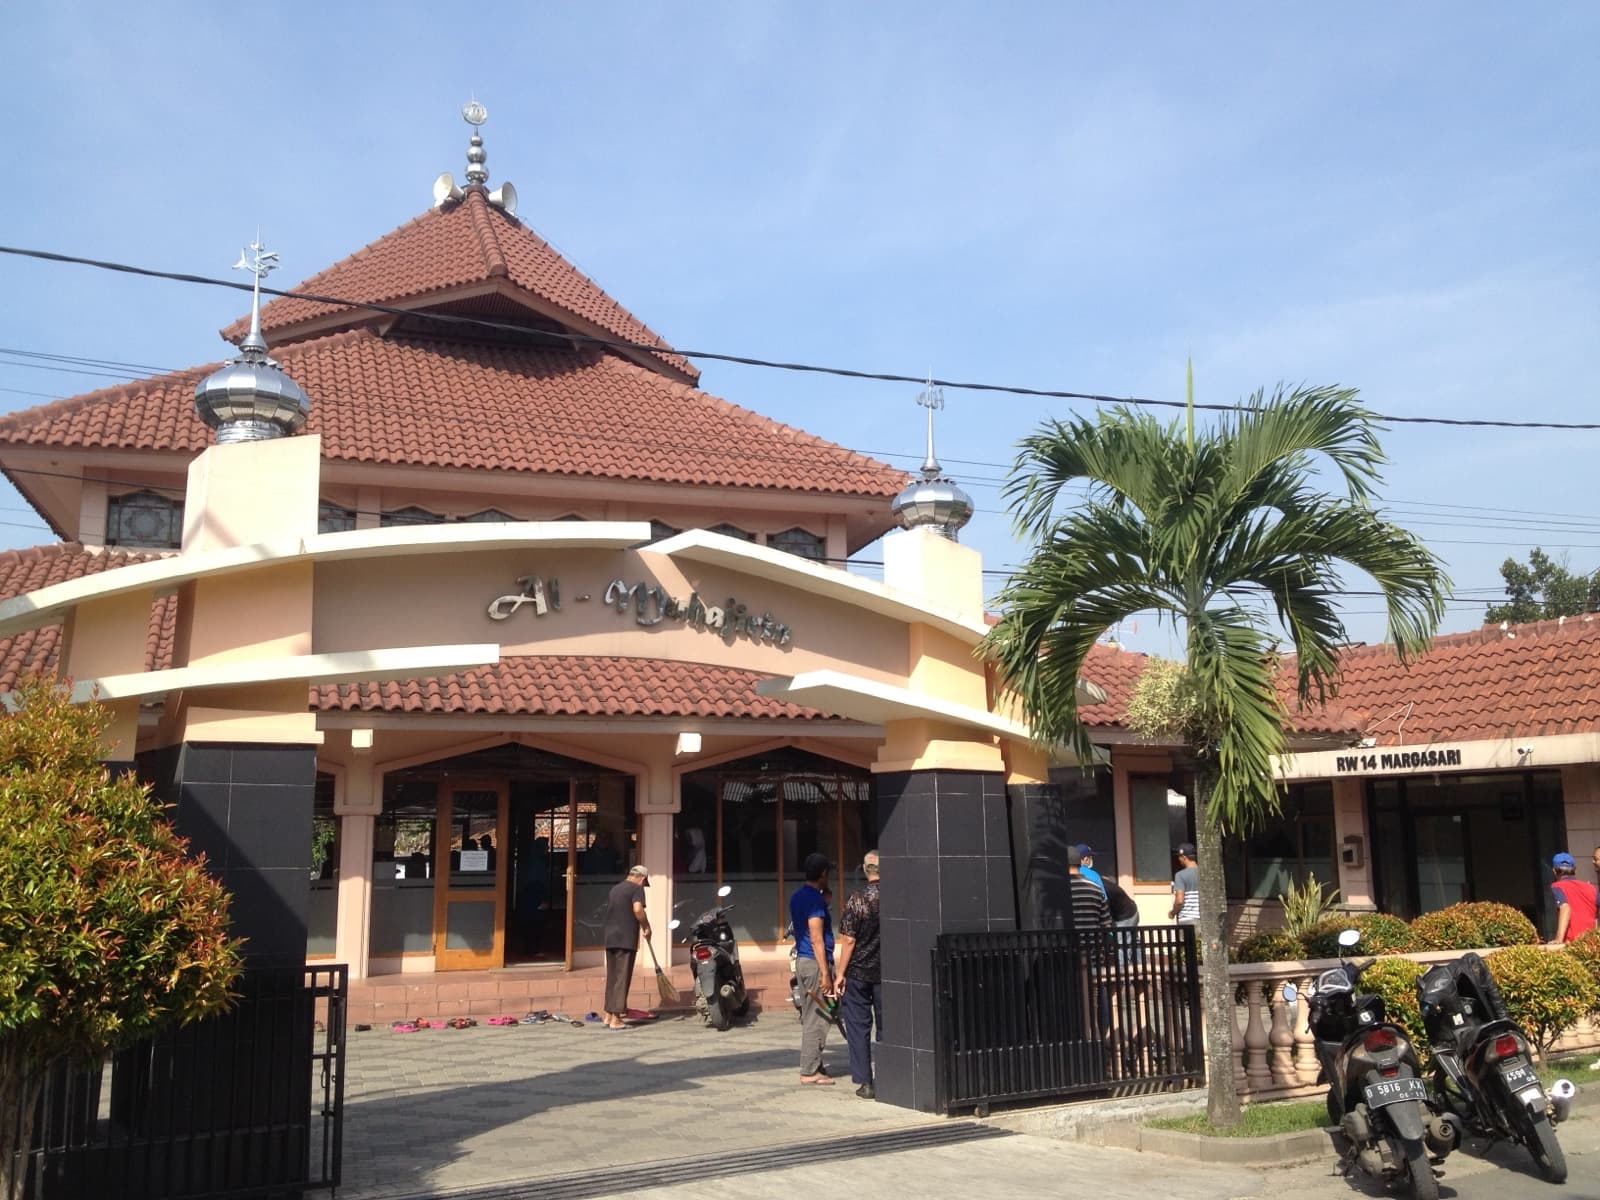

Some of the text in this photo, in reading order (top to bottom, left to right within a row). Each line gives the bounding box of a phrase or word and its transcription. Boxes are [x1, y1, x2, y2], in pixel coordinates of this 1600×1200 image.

[488, 575, 561, 620] Al
[1336, 749, 1462, 772] RW 14 MARGASARI
